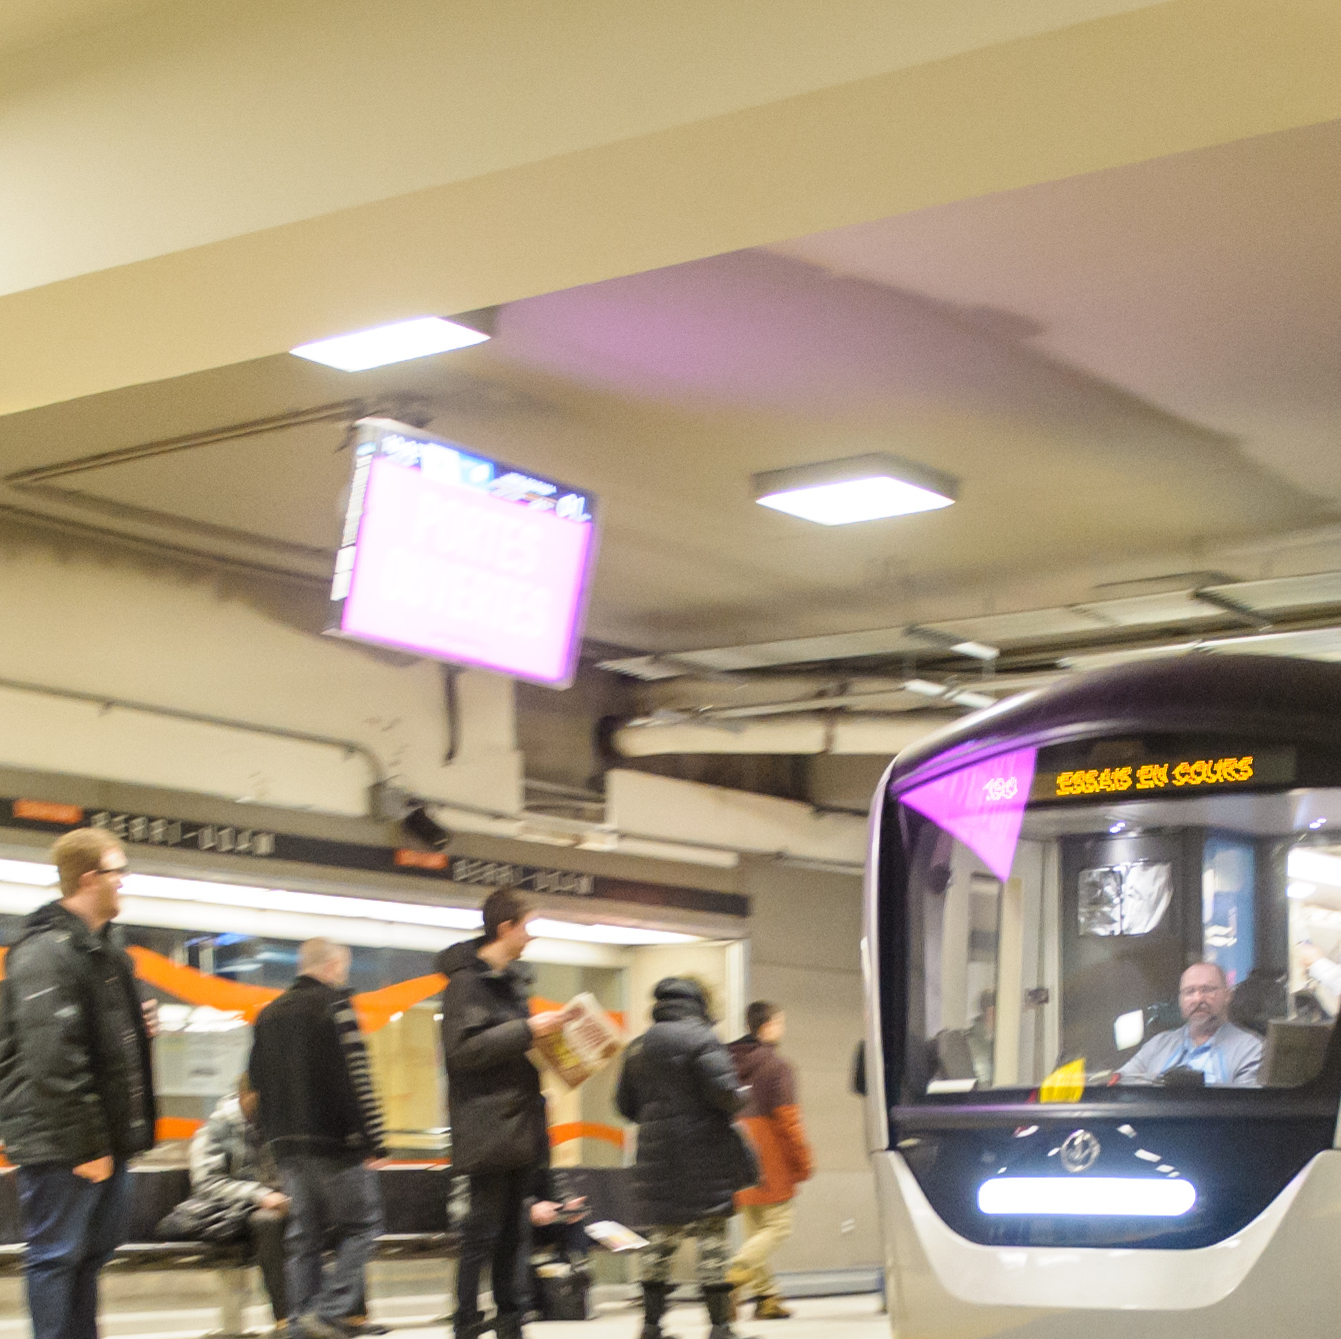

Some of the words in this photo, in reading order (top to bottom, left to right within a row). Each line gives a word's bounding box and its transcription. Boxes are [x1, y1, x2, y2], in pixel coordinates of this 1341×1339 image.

[1056, 766, 1133, 796] ESSAIS
[1136, 763, 1168, 789] EN
[1172, 757, 1254, 786] COURS
